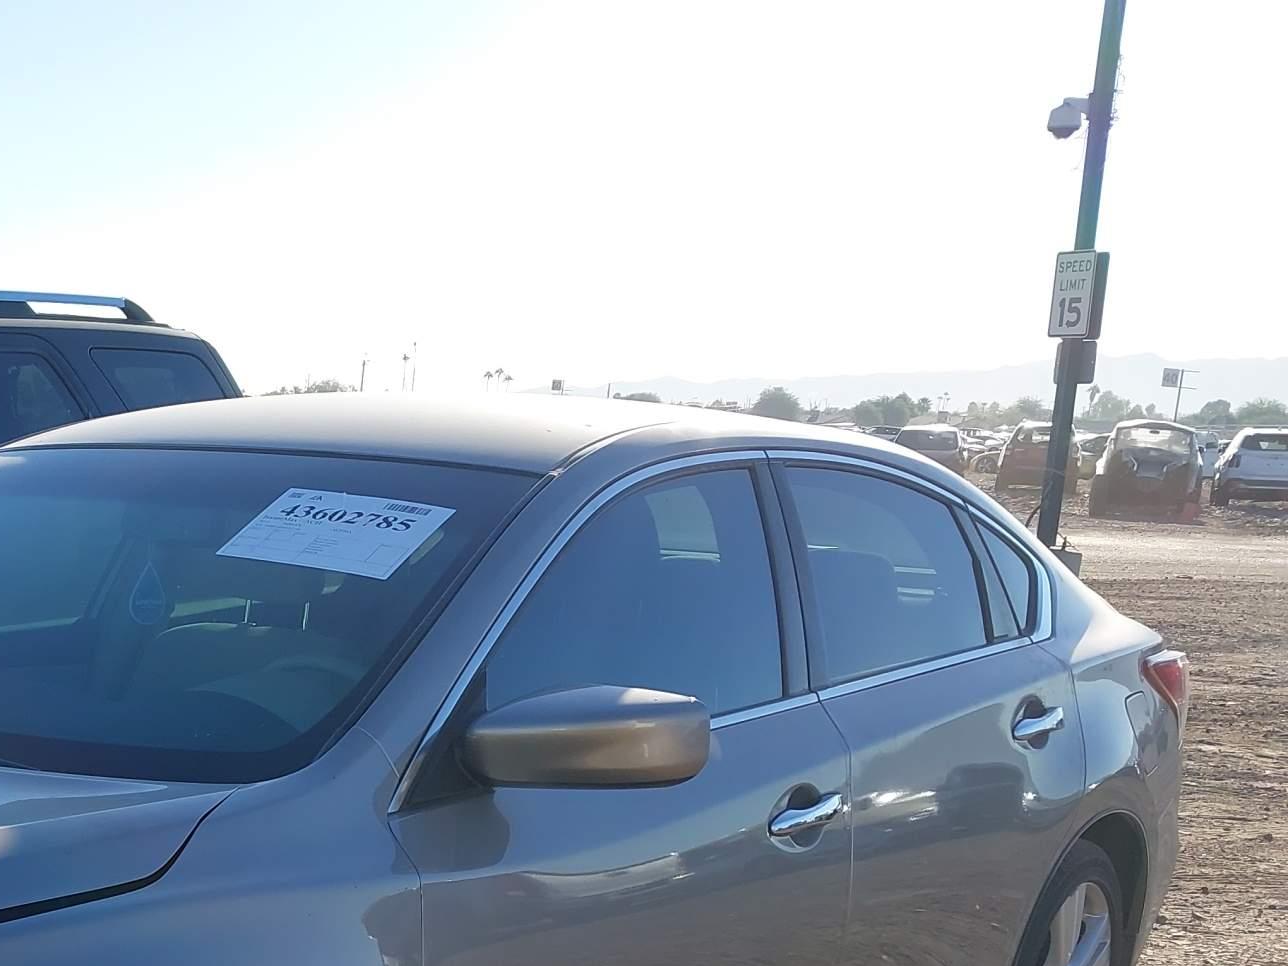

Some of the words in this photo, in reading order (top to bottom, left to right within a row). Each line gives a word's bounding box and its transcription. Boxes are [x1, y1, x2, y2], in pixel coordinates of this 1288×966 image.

[1058, 260, 1092, 274] SPEED
[1059, 279, 1087, 292] LIMIT
[1057, 297, 1082, 329] 15
[279, 503, 418, 533] 43602785
